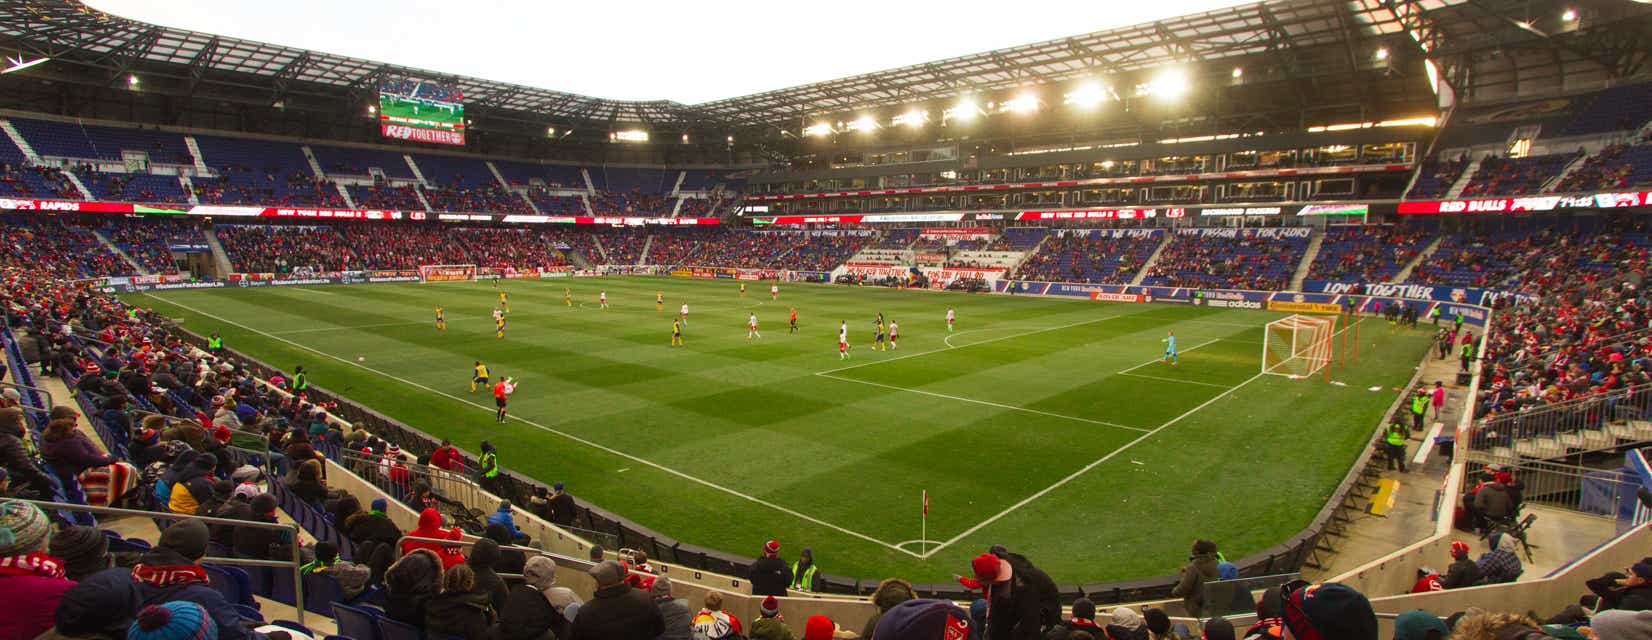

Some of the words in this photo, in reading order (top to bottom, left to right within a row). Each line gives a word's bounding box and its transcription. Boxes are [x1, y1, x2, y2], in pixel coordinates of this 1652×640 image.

[40, 202, 79, 211] RAPIDS
[1439, 202, 1466, 212] RED
[1467, 200, 1507, 212] BULLS
[1364, 284, 1434, 300] TOGETHER
[1228, 300, 1262, 310] adidas
